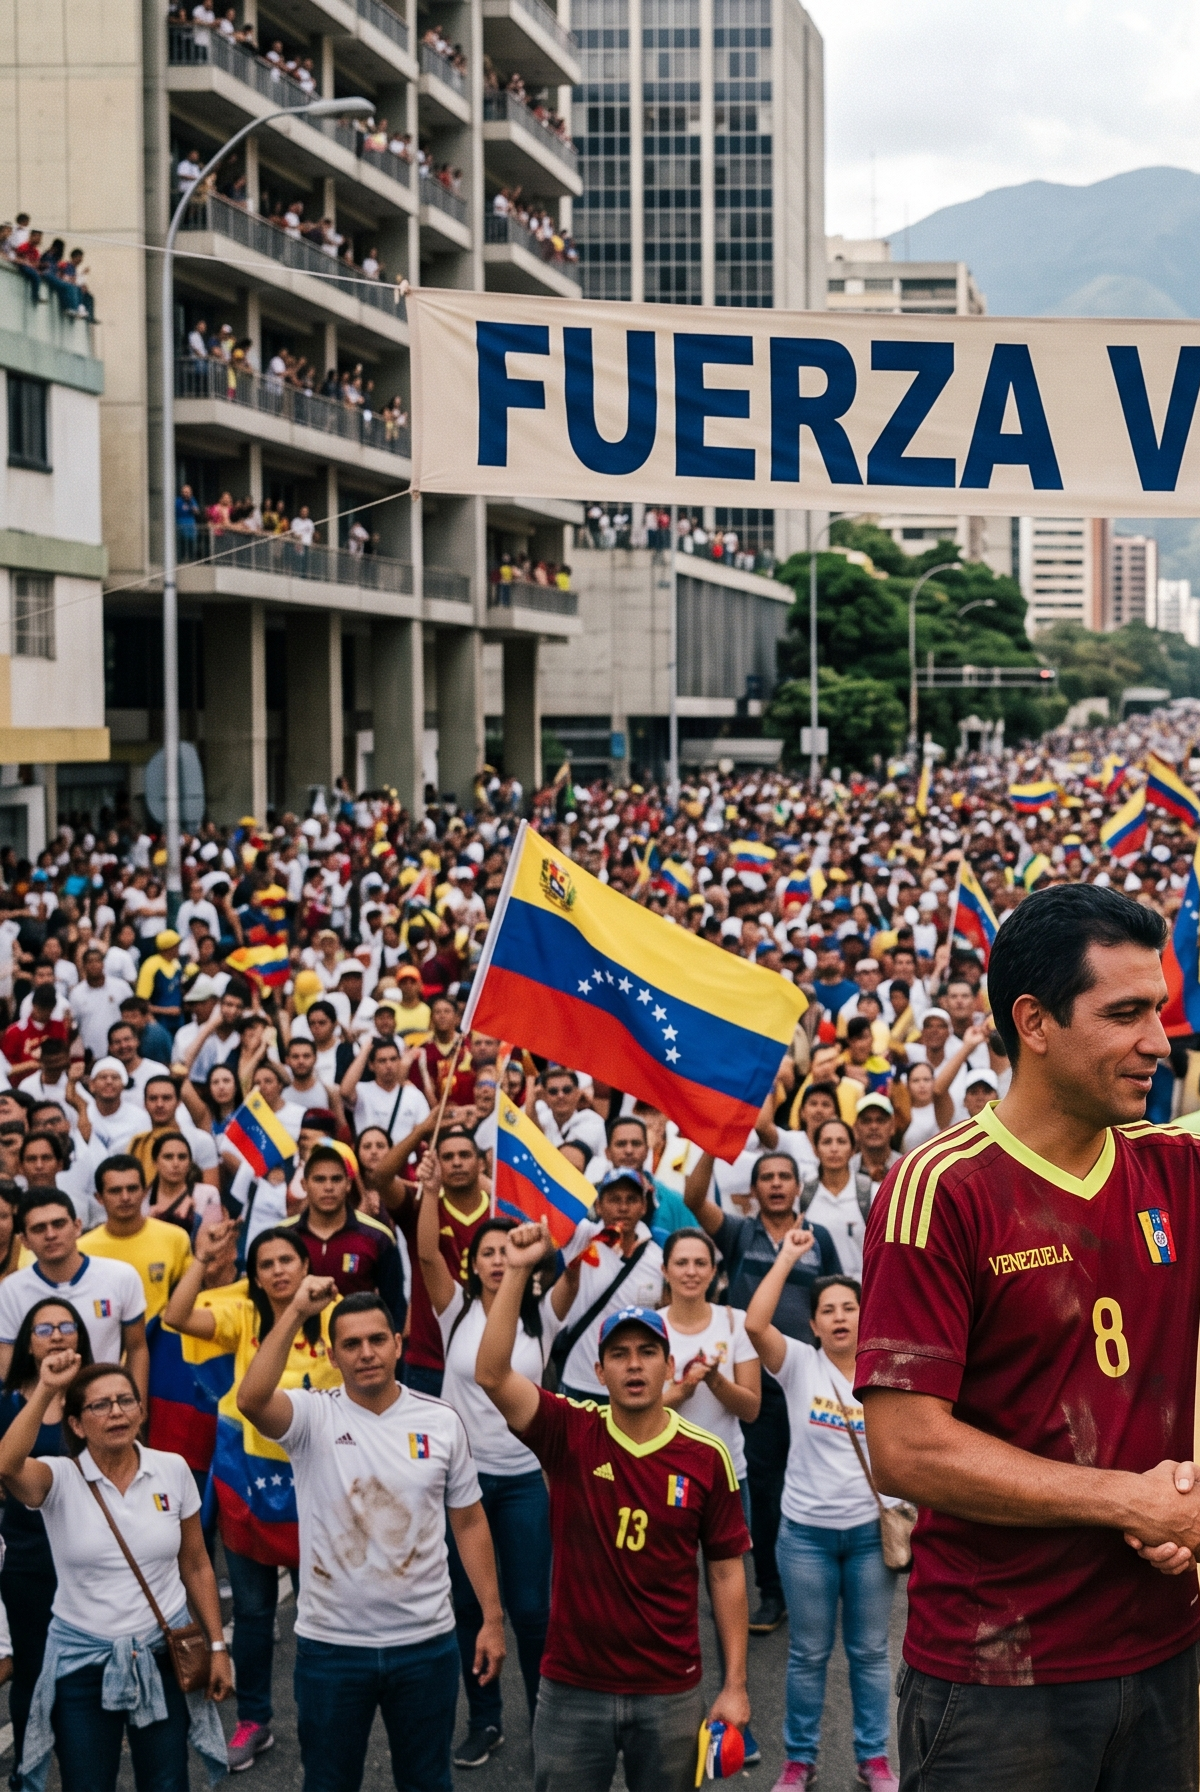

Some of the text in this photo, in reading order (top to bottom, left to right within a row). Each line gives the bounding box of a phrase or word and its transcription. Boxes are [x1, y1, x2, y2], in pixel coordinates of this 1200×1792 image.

[476, 321, 1063, 490] FUERZA
[988, 1243, 1074, 1276] VENEZUELA
[1092, 1296, 1130, 1378] 8
[615, 1506, 648, 1552] 13
